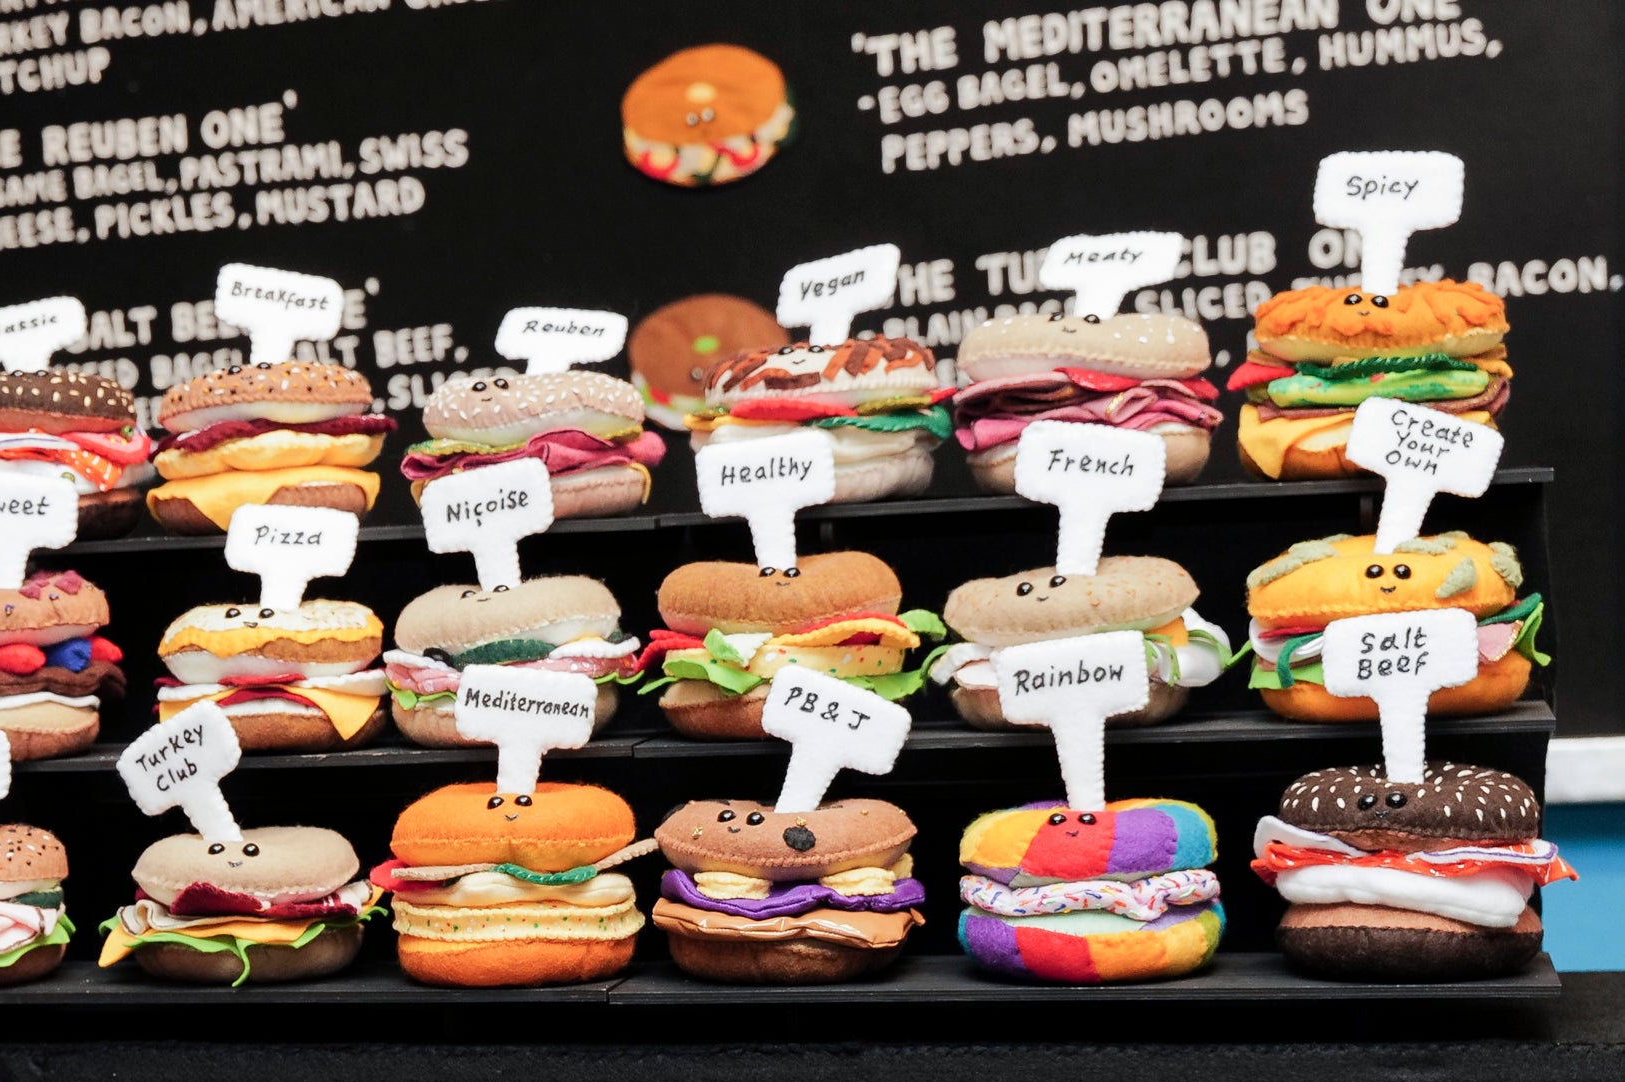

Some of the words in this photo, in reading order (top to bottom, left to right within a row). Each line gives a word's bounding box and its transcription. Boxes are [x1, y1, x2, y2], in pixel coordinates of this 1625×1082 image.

[982, 0, 1340, 64] MEDITERRANEAN
[878, 83, 950, 124] EGG
[1067, 88, 1310, 148] MUSHROOMS
[41, 113, 188, 166] REUBEN
[359, 128, 469, 174] SWISS
[255, 175, 426, 226] MUSTARD
[1347, 175, 1419, 200] Spicy
[1063, 249, 1144, 266] Meaty
[799, 268, 866, 299] Vegan
[1134, 279, 1273, 322] SLICED
[521, 319, 606, 338] Reuben
[1390, 409, 1475, 448] Create
[1396, 429, 1451, 459] Your
[720, 456, 813, 487] Healthy
[1048, 449, 1135, 478] French
[1385, 451, 1439, 476] Own
[446, 488, 530, 528] Niçoise
[254, 524, 324, 546] Pizza
[1359, 626, 1429, 655] Salt
[1013, 659, 1124, 696] Rainbow
[1356, 652, 1430, 681] Beef
[464, 686, 591, 720] Mediterranean
[156, 758, 199, 793] Club
